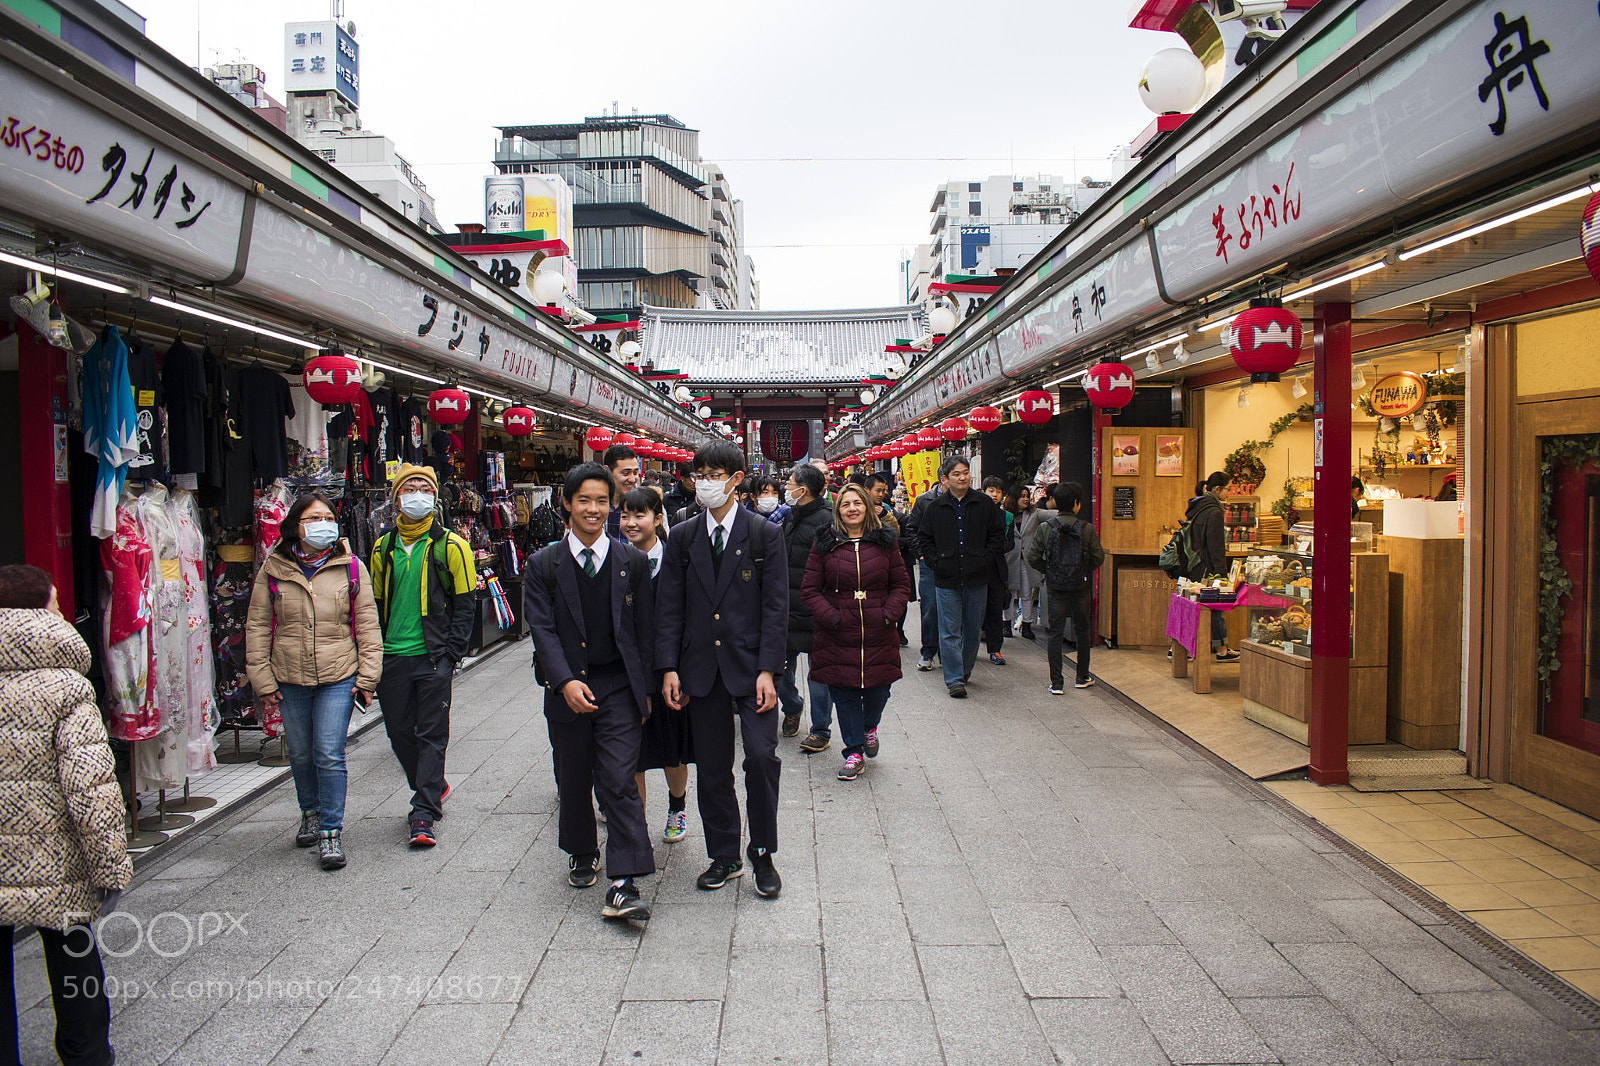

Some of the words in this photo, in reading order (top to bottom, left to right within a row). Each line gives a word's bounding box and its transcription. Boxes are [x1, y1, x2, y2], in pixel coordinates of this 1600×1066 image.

[291, 55, 326, 72] 三定
[0, 115, 85, 175] ふくろもの
[488, 200, 522, 216] Asahi
[417, 294, 491, 362] フジヤ
[501, 349, 538, 381] FUJIYA
[1374, 384, 1418, 404] FUNAWA
[1228, 483, 1257, 496] HOT
[1133, 579, 1178, 590] DUSTBO
